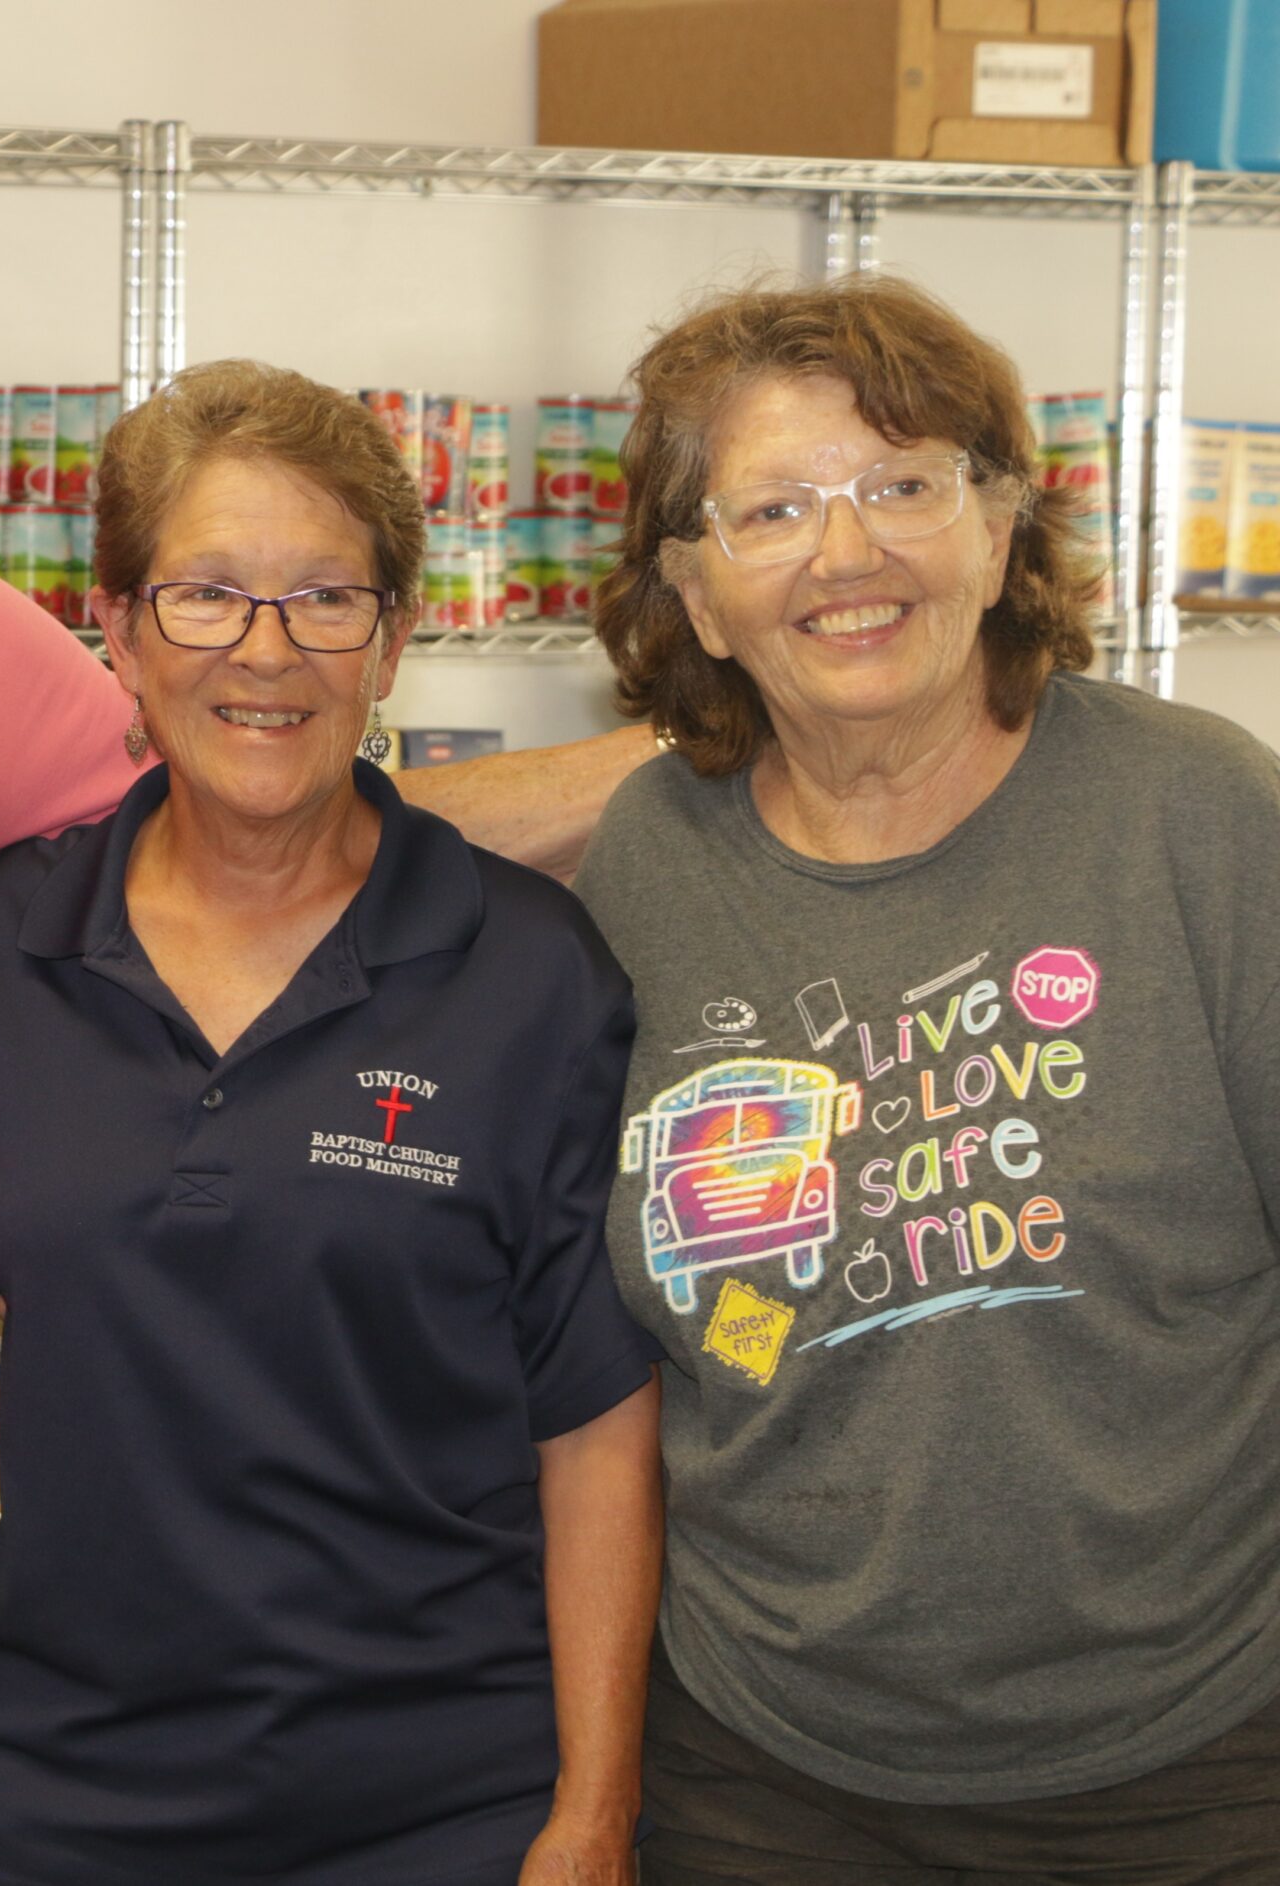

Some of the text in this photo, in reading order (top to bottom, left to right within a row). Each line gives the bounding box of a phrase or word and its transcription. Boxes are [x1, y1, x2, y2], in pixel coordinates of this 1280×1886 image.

[1021, 969, 1089, 1003] STOP
[857, 979, 1001, 1081] Live
[356, 1070, 439, 1099] UNION
[309, 1150, 459, 1186] FOOD MINISTRY
[310, 1131, 461, 1170] BAPTIST CHURCH
[858, 1117, 1042, 1217] safe
[733, 1332, 773, 1356] first
